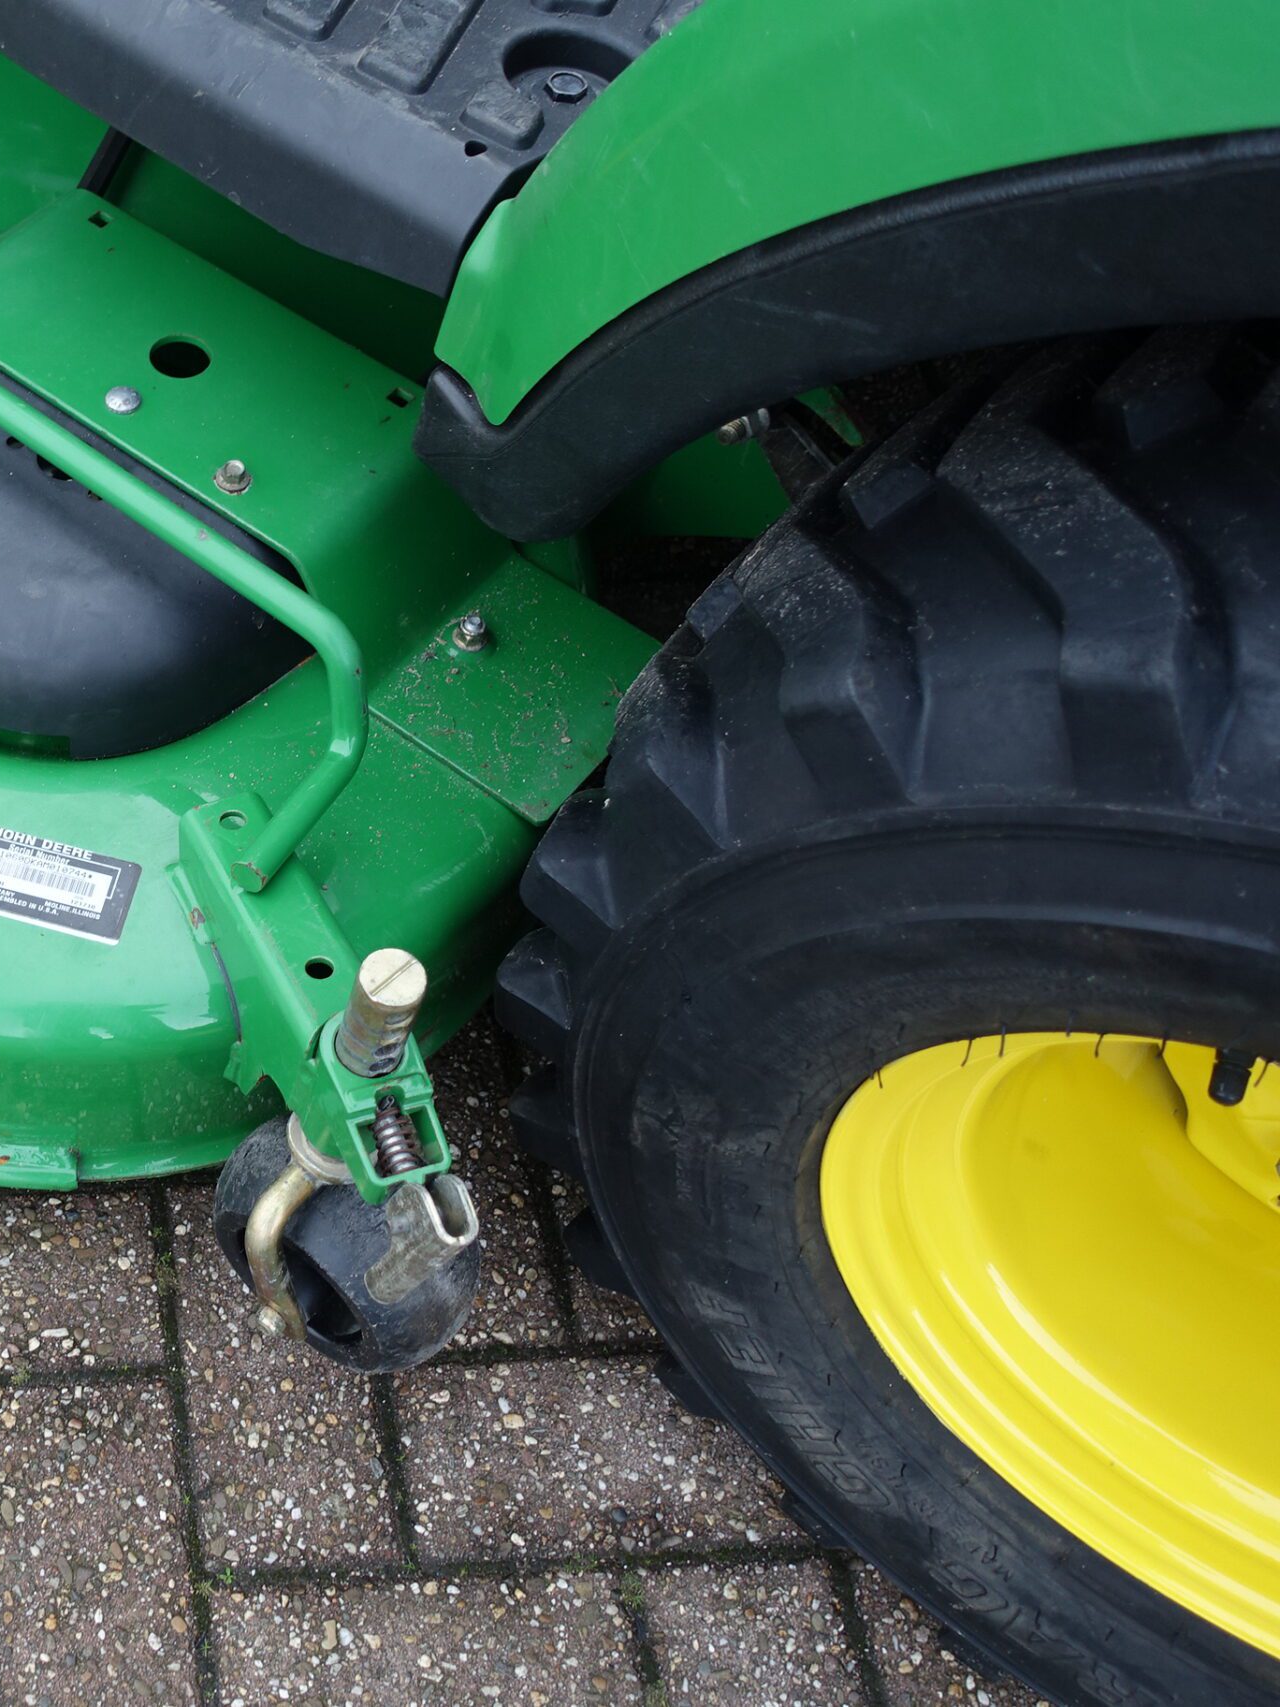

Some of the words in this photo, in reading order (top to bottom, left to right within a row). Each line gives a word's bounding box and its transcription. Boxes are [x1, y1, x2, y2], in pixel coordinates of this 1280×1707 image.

[8, 843, 34, 856] Serial
[36, 850, 70, 865] Number
[41, 838, 93, 860] DEERE
[686, 1283, 893, 1506] CHIEF
